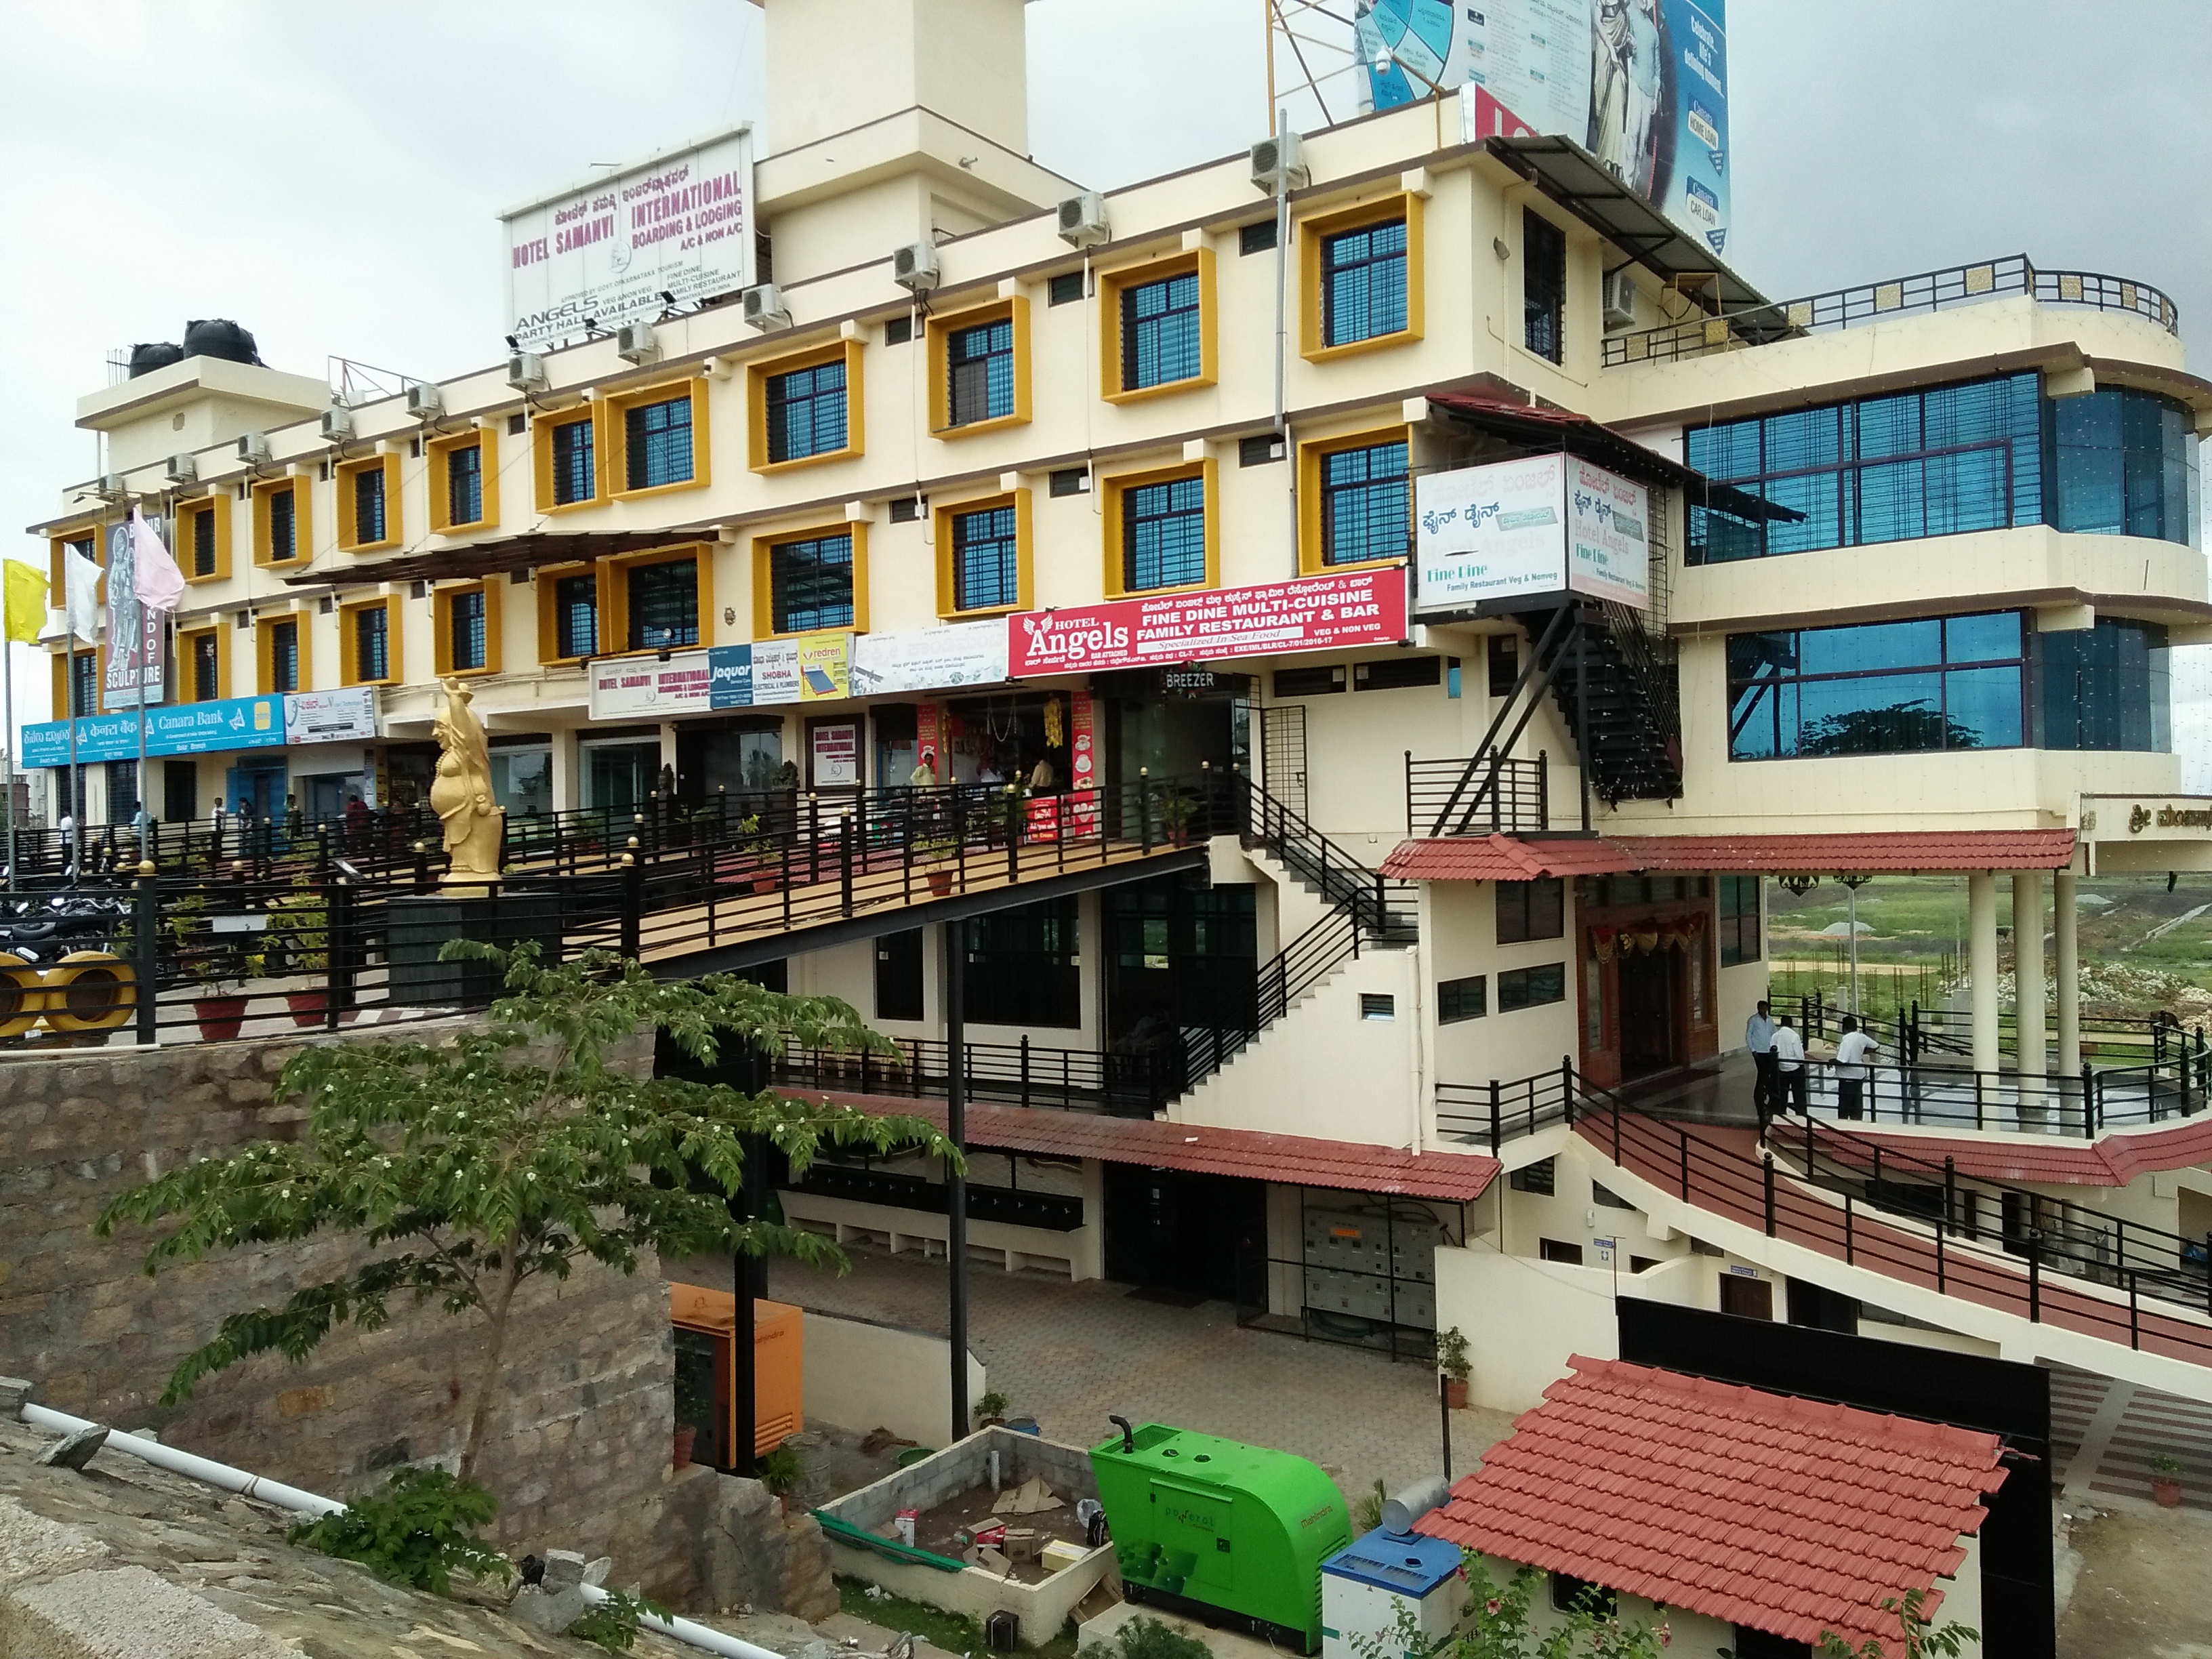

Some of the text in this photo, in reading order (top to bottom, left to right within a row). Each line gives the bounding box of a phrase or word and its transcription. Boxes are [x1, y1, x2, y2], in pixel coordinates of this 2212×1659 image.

[1690, 115, 1717, 148] HOME LOAN
[1694, 182, 1713, 207] Canara
[513, 171, 742, 269] HOTEL SAMANVI INTERNATIONAL
[1690, 200, 1716, 226] CAR LOAN
[632, 199, 742, 249] BOARDING & LODGING
[680, 222, 743, 251] A/C & NON A/C
[657, 261, 683, 274] TOURISM
[668, 268, 719, 289] MULTI-CUISINE
[671, 270, 741, 296] AMILY RESTAURANT
[637, 285, 652, 296] VEG
[514, 325, 554, 340] PARTY
[556, 314, 586, 330] HALL
[594, 292, 662, 319] AVAILABLE
[516, 295, 599, 332] ANGELS
[1422, 501, 1500, 535] ಫೈನ್ ಡೈನ್
[1575, 519, 1599, 544] Hotel
[1602, 529, 1629, 555] Angels
[1338, 579, 1347, 589] &
[1349, 575, 1373, 588] ಬಾರ್
[1427, 568, 1455, 583] Fine
[1447, 583, 1469, 592] Family
[1470, 577, 1507, 589] Restaurant
[1509, 575, 1522, 585] Veg
[1532, 572, 1558, 581] Nonveg
[1142, 589, 1373, 627] FINE DINE MULTI-CUISINE
[1054, 617, 1099, 631] HOTEL
[1136, 604, 1380, 640] FAMILY RESTAURANT & BAR
[1314, 623, 1381, 636] VEG & NON VEG
[1026, 621, 1129, 660] Angels
[1158, 637, 1216, 650] Specialized
[1229, 632, 1248, 642] Sea
[1251, 630, 1281, 640] Food
[813, 647, 841, 658] redren
[621, 675, 651, 689] SAMANVI
[658, 669, 710, 684] INTERNATIONAL
[762, 670, 792, 680] SHOBHA
[1166, 672, 1214, 688] BREEZER
[754, 682, 775, 691] ELECTRICAL
[779, 680, 800, 689] PLUMBERS
[90, 723, 118, 737] केनरा
[159, 710, 224, 730] Canara Bank
[2128, 804, 2152, 834] ಶ್ರೀ
[1166, 1507, 1214, 1527] powerol
